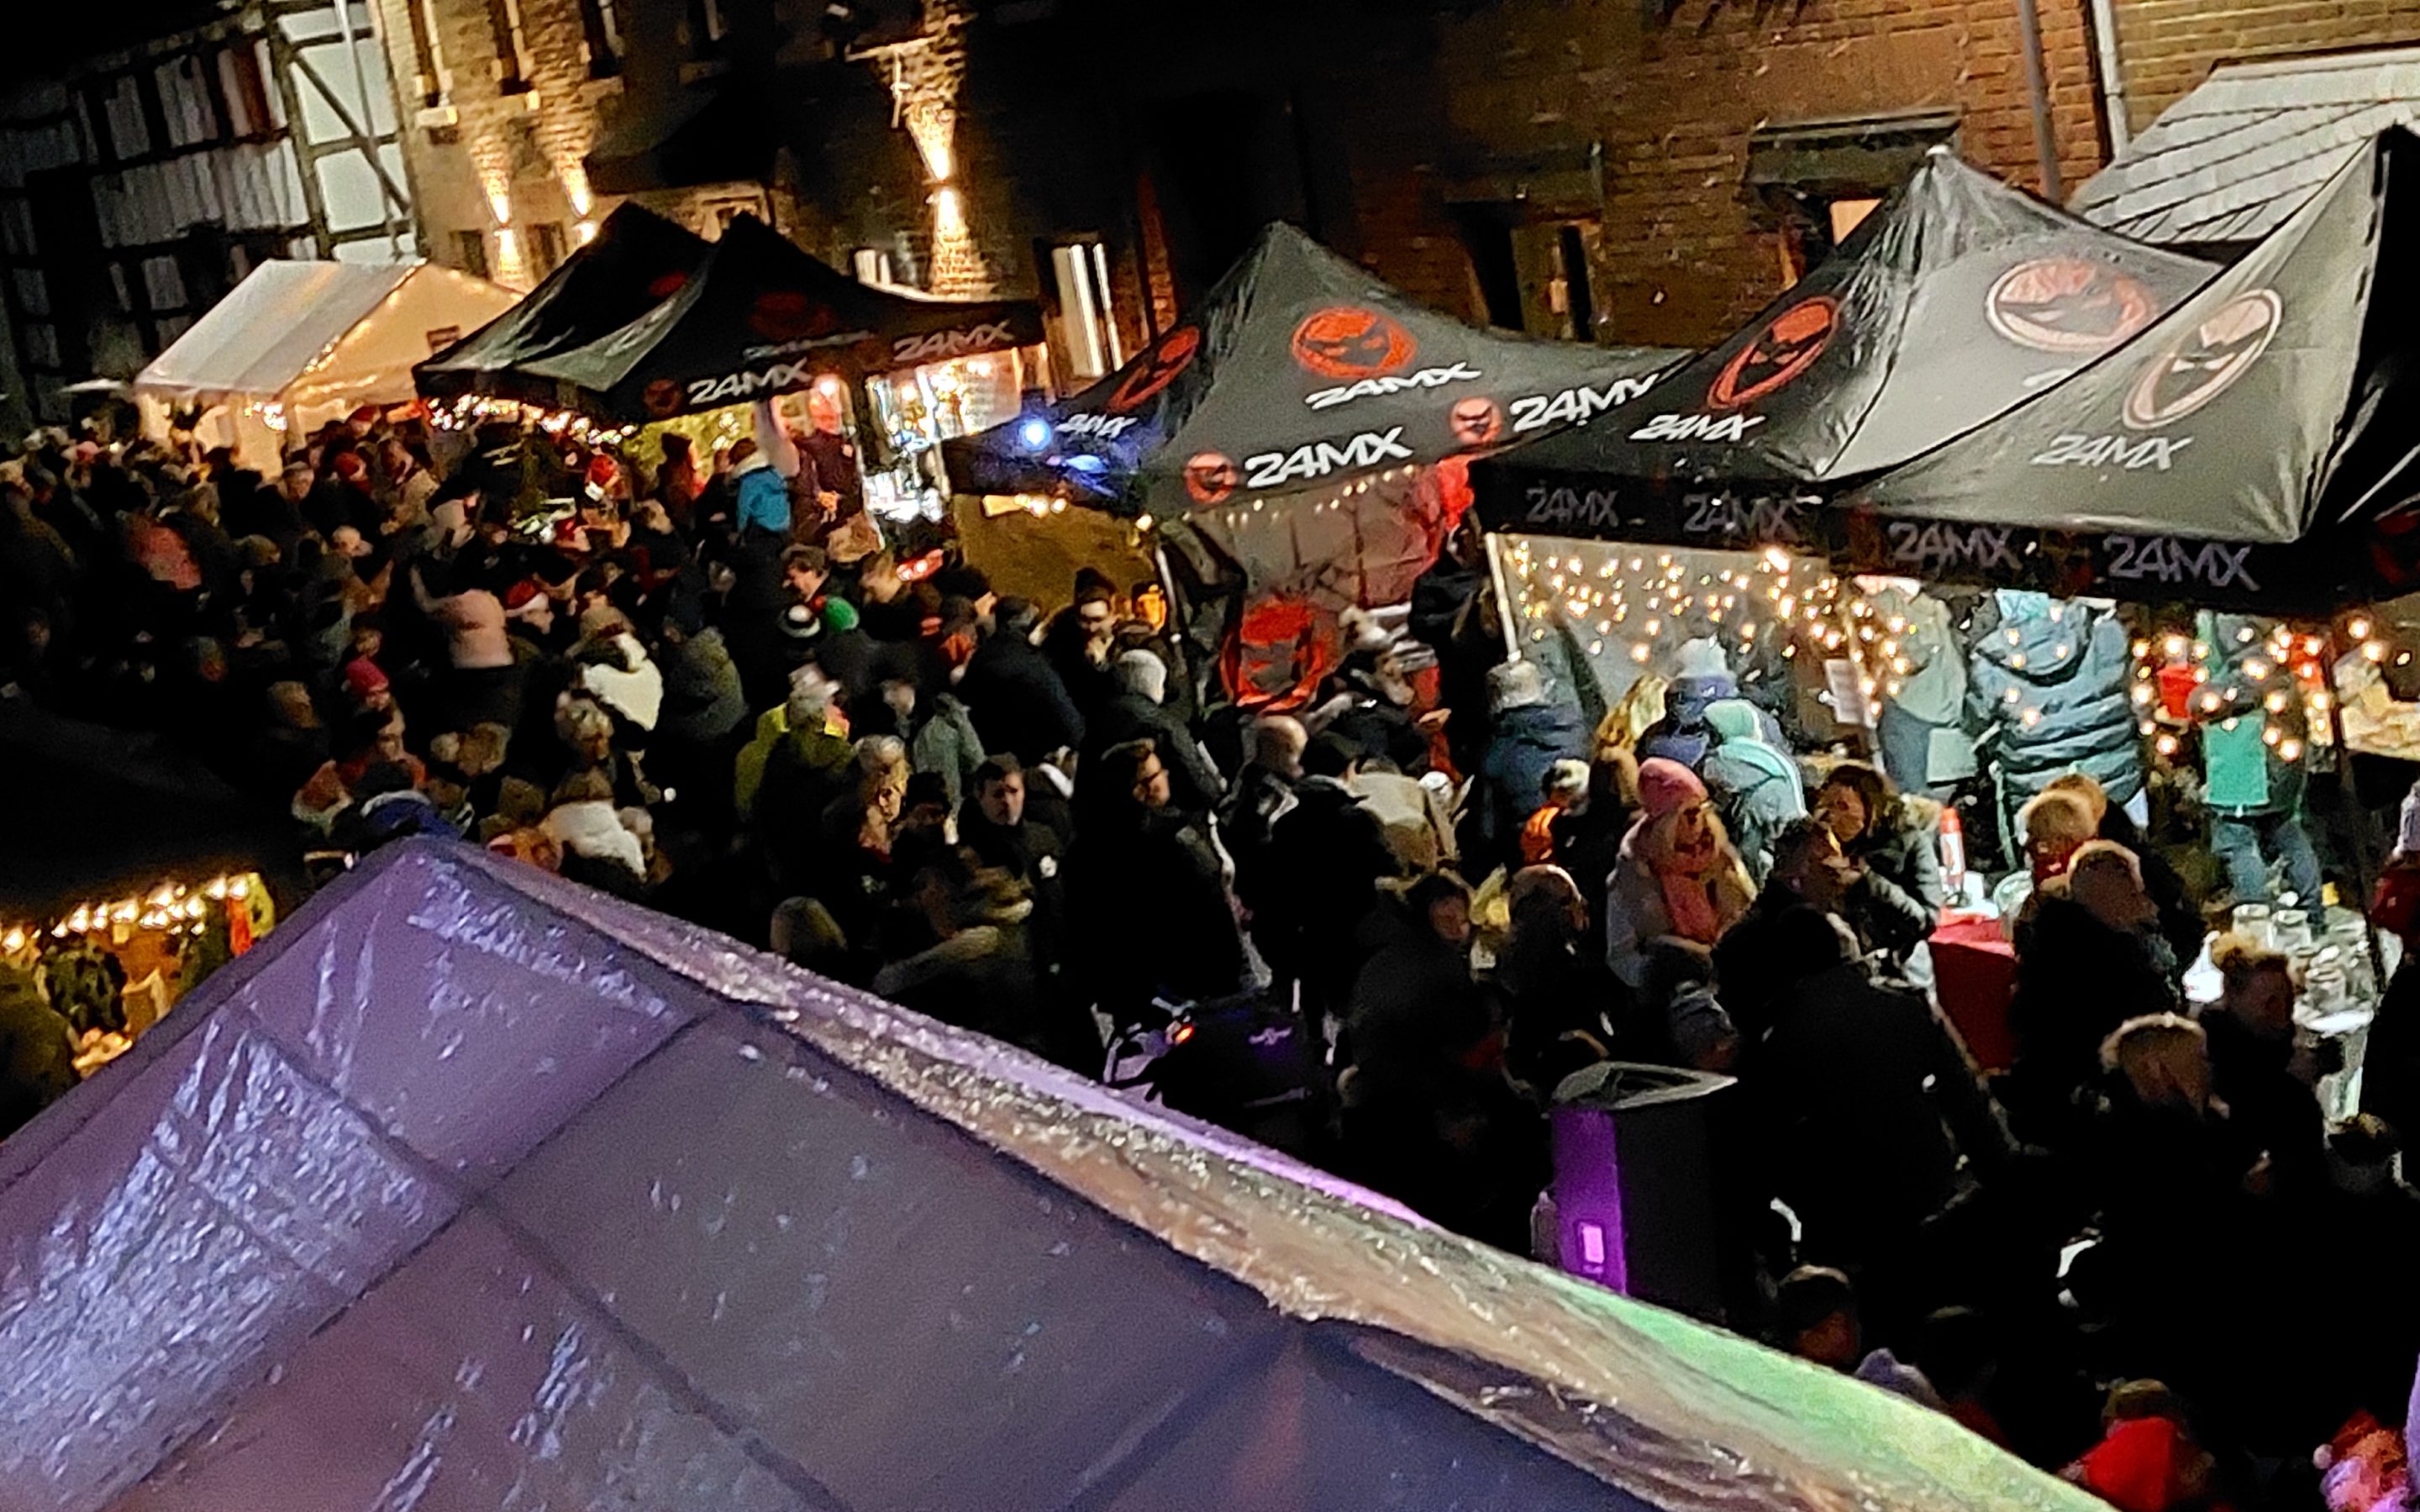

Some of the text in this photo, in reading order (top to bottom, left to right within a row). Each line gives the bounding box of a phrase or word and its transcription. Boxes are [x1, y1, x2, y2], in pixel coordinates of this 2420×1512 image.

[687, 357, 812, 406] 24MX
[1305, 361, 1482, 410] 24MX
[1244, 426, 1414, 489] 24MX
[2029, 434, 2195, 471] 24MX
[1526, 486, 1620, 528] 24MX
[1888, 521, 2022, 571] 24MX
[2104, 532, 2261, 591] 24MX
